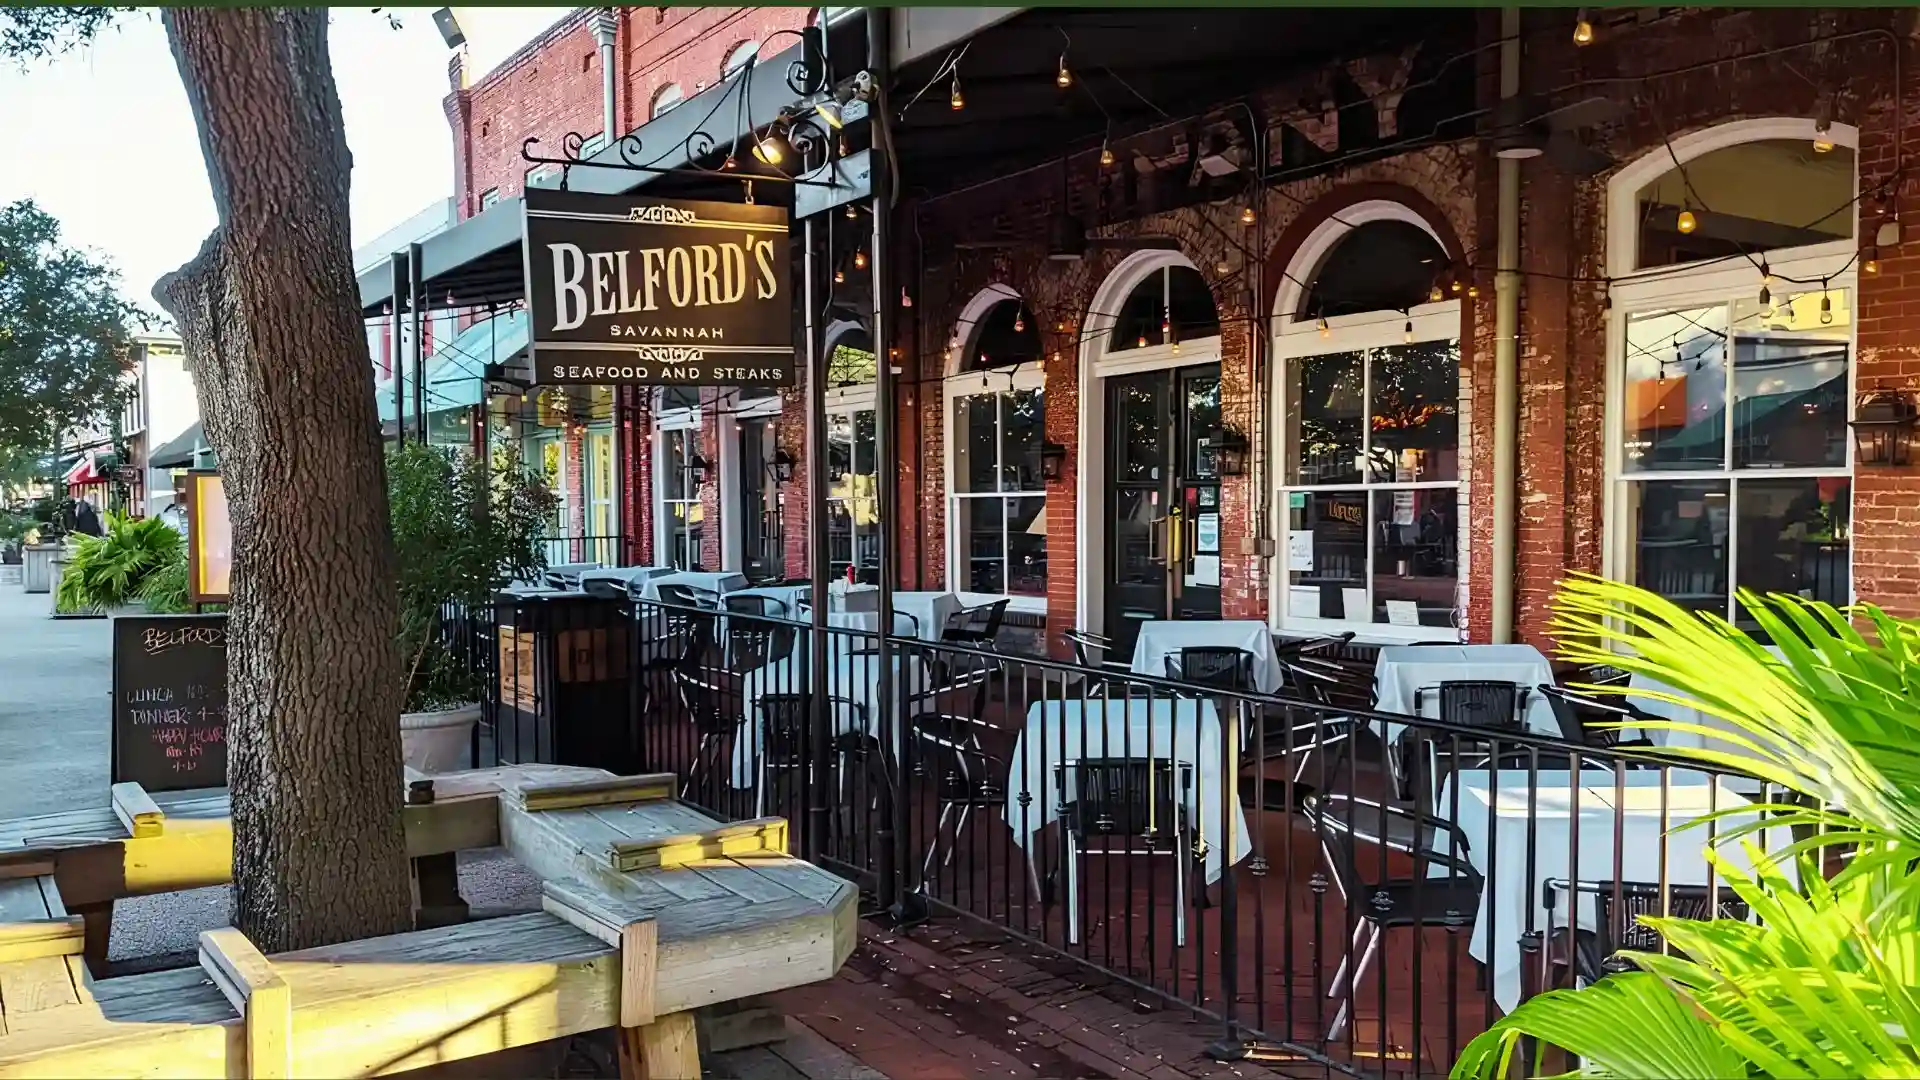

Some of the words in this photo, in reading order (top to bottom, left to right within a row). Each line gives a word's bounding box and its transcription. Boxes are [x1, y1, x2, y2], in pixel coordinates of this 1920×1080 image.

[547, 234, 778, 332] BELFORD'S
[610, 324, 724, 339] SAVANNAH
[553, 365, 649, 379] SEAFOOD
[661, 366, 701, 380] AND
[713, 367, 783, 381] STEAKS
[141, 625, 228, 653] BELFORD
